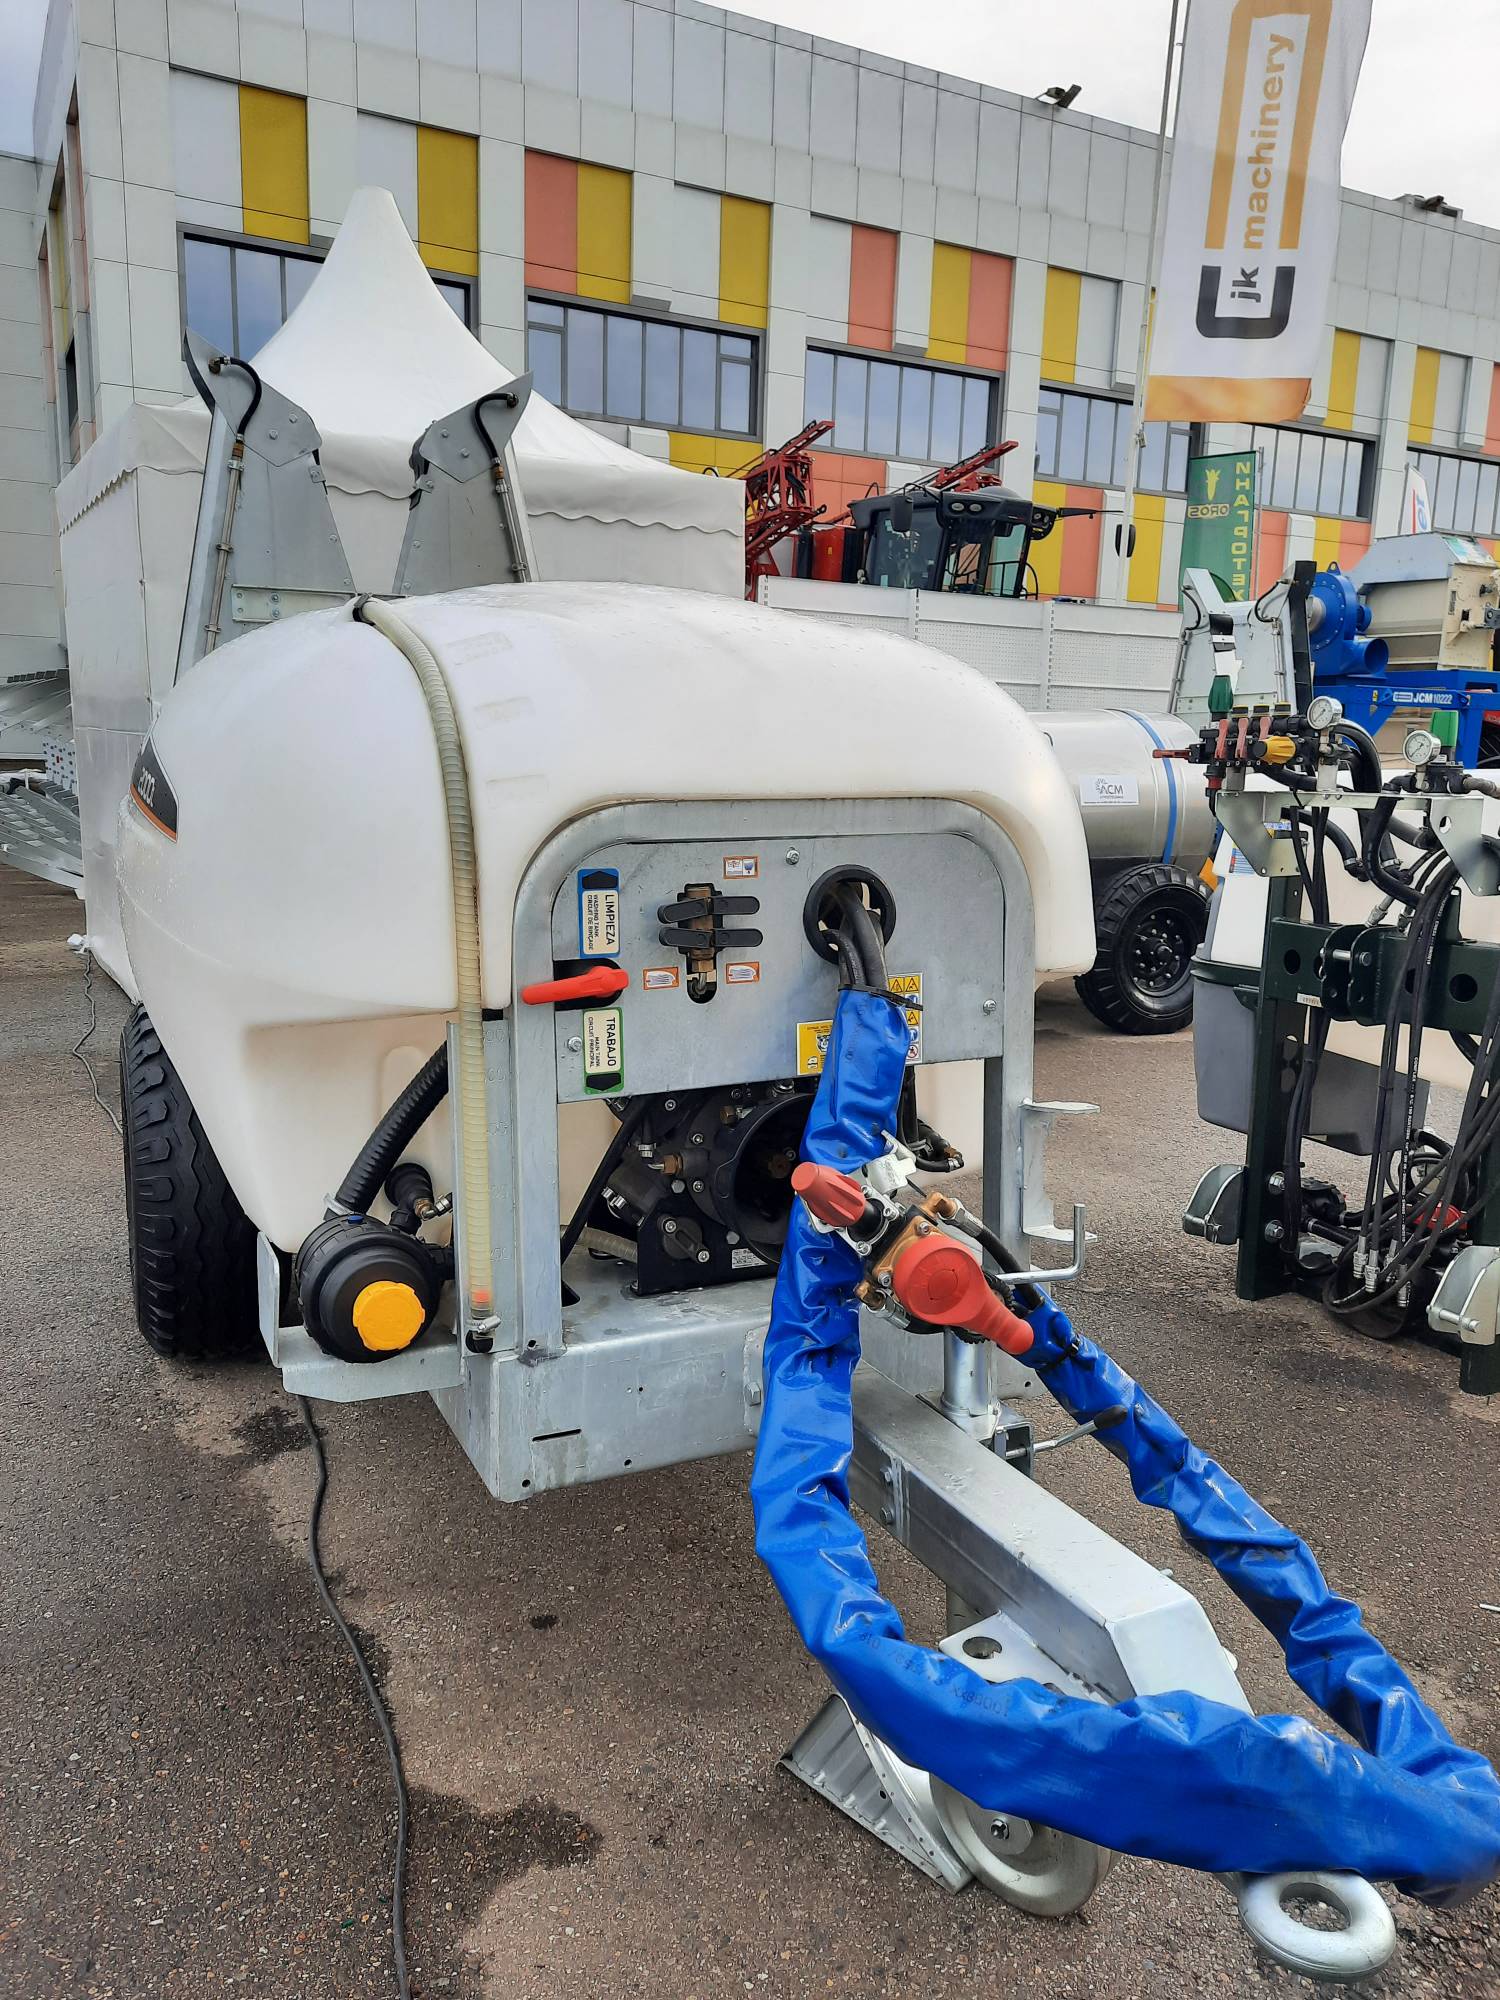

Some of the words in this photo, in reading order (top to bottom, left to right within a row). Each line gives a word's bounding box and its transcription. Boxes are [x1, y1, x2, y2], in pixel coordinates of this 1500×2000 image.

[1243, 33, 1294, 250] machinery
[1230, 266, 1262, 304] jk
[1413, 692, 1433, 704] JCM
[605, 894, 616, 945] LIMPIEZA
[606, 1017, 616, 1066] TRABAJO
